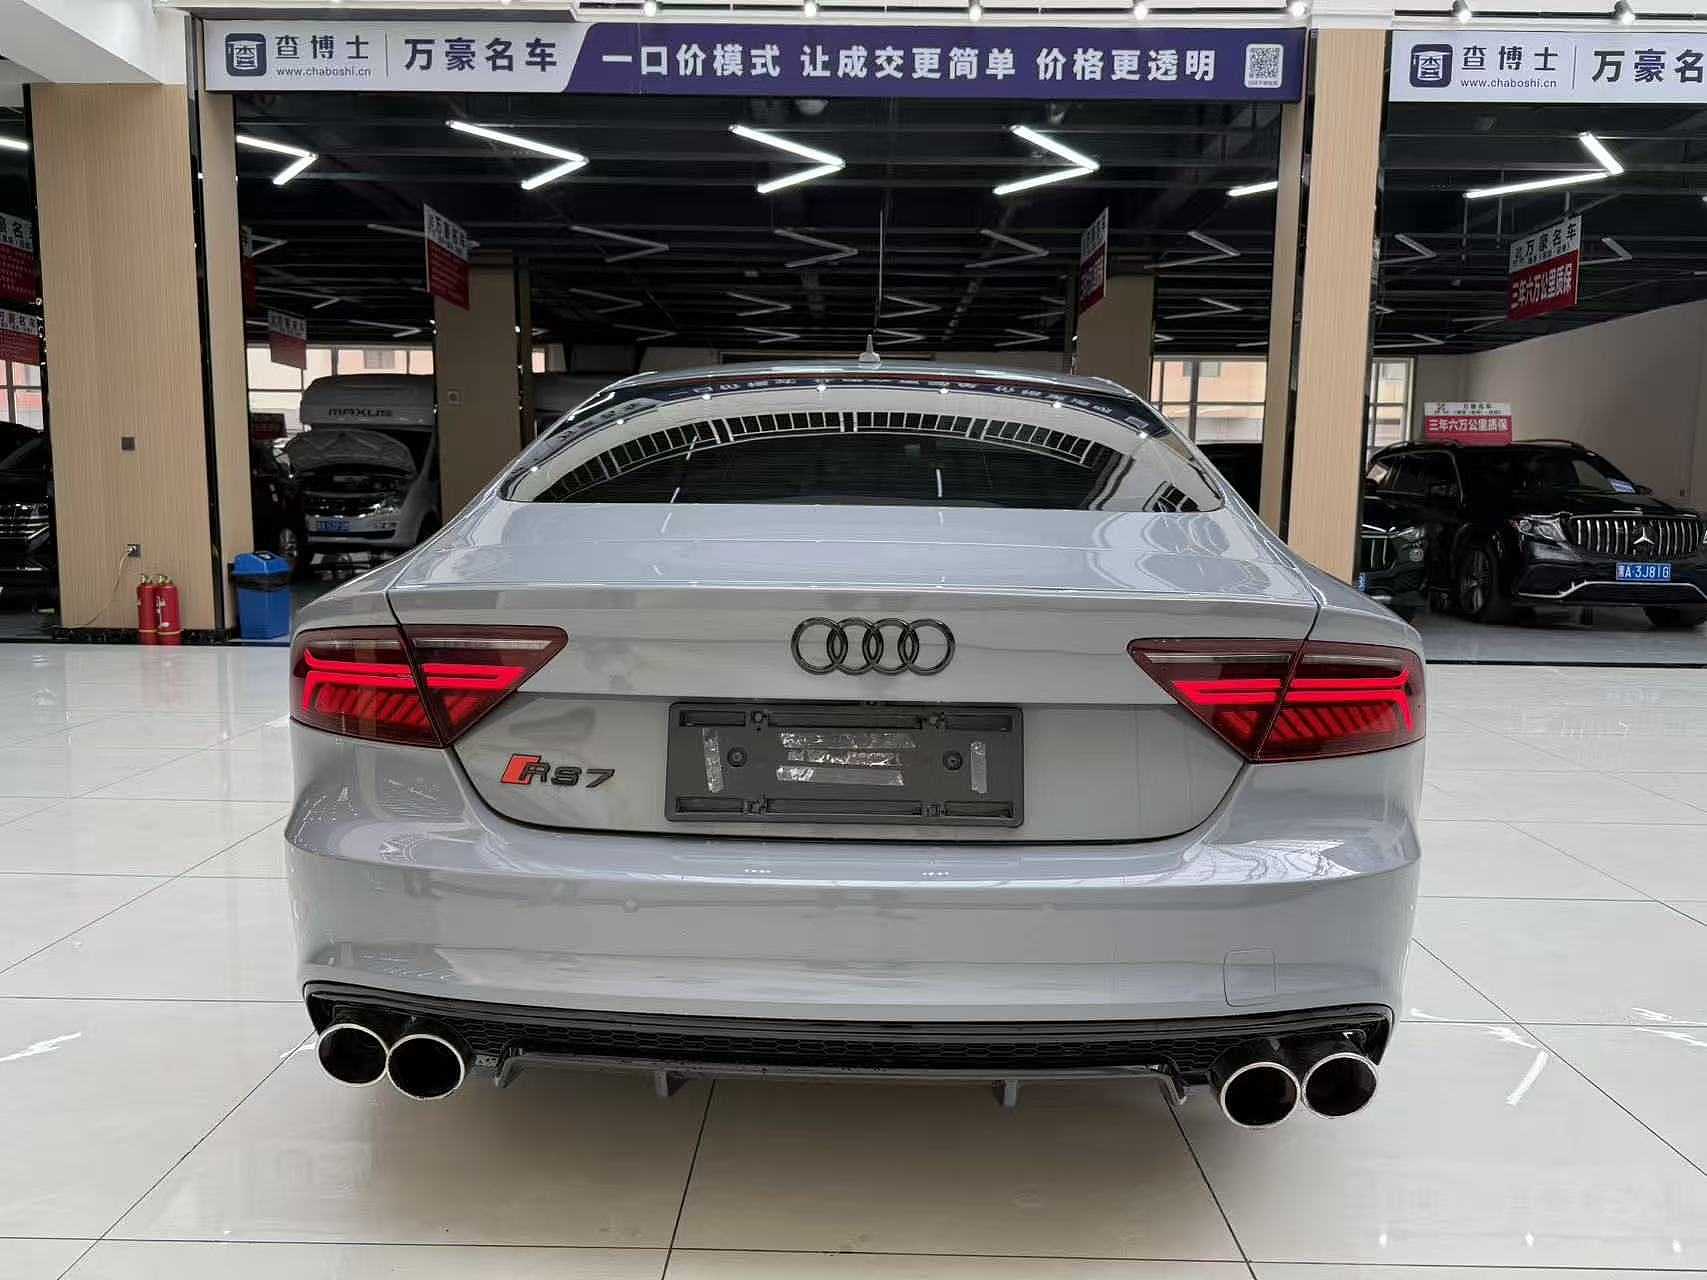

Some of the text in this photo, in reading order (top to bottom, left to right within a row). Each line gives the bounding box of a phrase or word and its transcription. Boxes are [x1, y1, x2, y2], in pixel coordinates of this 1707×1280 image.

[275, 35, 369, 59] 查博士
[404, 37, 557, 72] 万豪名车
[1461, 45, 1558, 71] 查博士
[277, 66, 371, 77] www.chaboshi.cn
[602, 44, 1216, 81] 一口价模式 让成交更简单 价格更透明
[1592, 48, 1704, 83] 万豪名
[1460, 78, 1557, 88] www.chaboshi.cn
[500, 753, 615, 788] RS7
